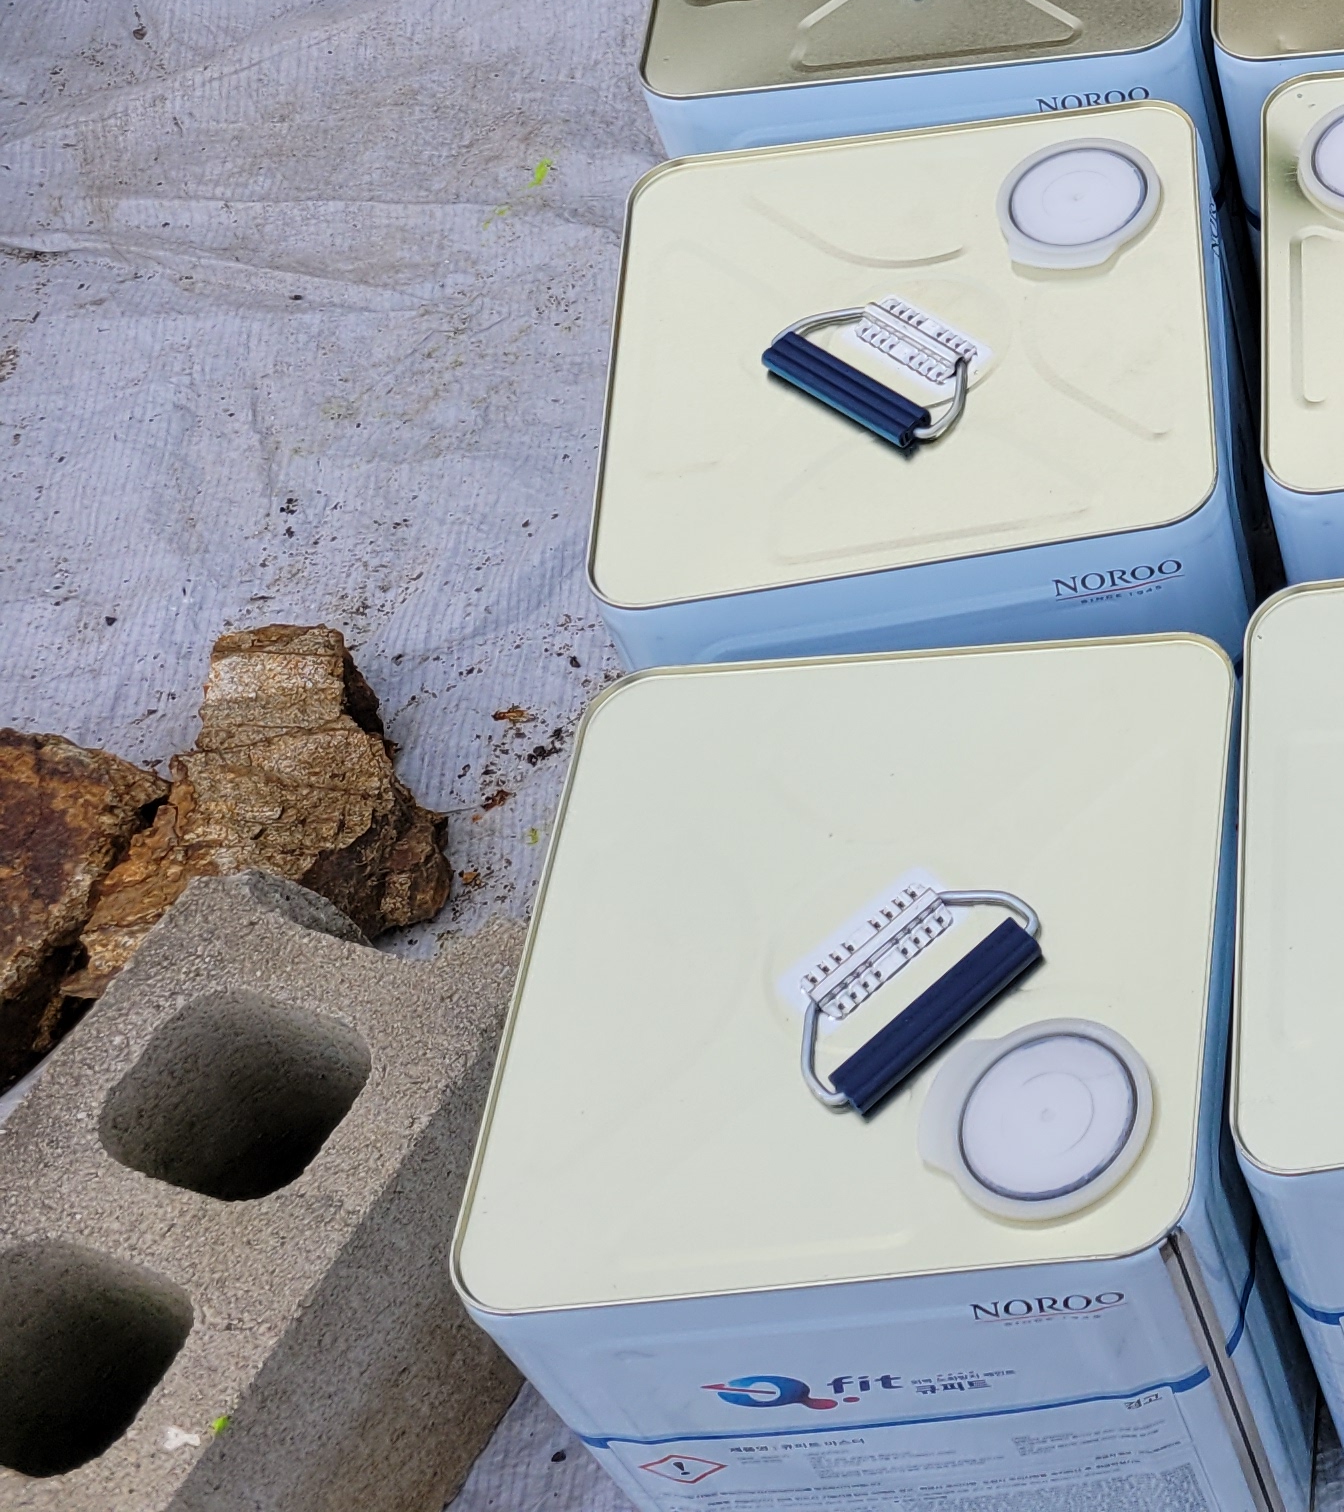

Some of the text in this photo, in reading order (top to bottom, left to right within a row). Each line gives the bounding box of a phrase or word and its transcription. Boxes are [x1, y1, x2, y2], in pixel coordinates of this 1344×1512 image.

[1036, 86, 1150, 113] NOROO
[1052, 559, 1182, 597] NOROO
[970, 1291, 1126, 1322] NOROO
[827, 1374, 903, 1394] fit
[915, 1379, 992, 1395] 큐피트
